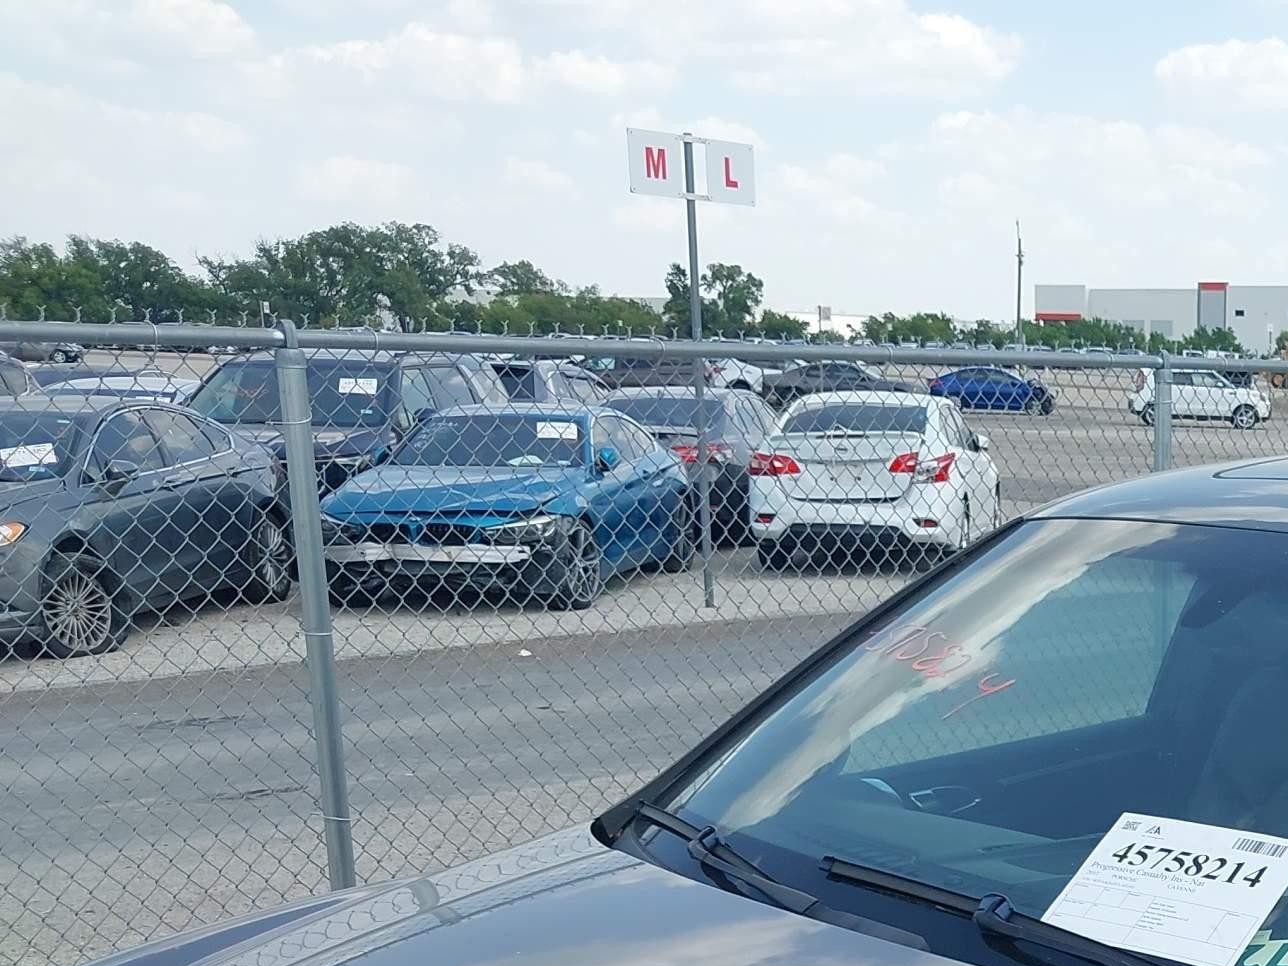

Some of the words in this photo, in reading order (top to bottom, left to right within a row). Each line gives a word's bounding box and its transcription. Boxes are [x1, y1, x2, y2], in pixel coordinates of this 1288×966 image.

[645, 146, 667, 180] M
[724, 156, 739, 189] L
[1090, 861, 1135, 875] Progressive
[1112, 842, 1269, 888] 45758214
